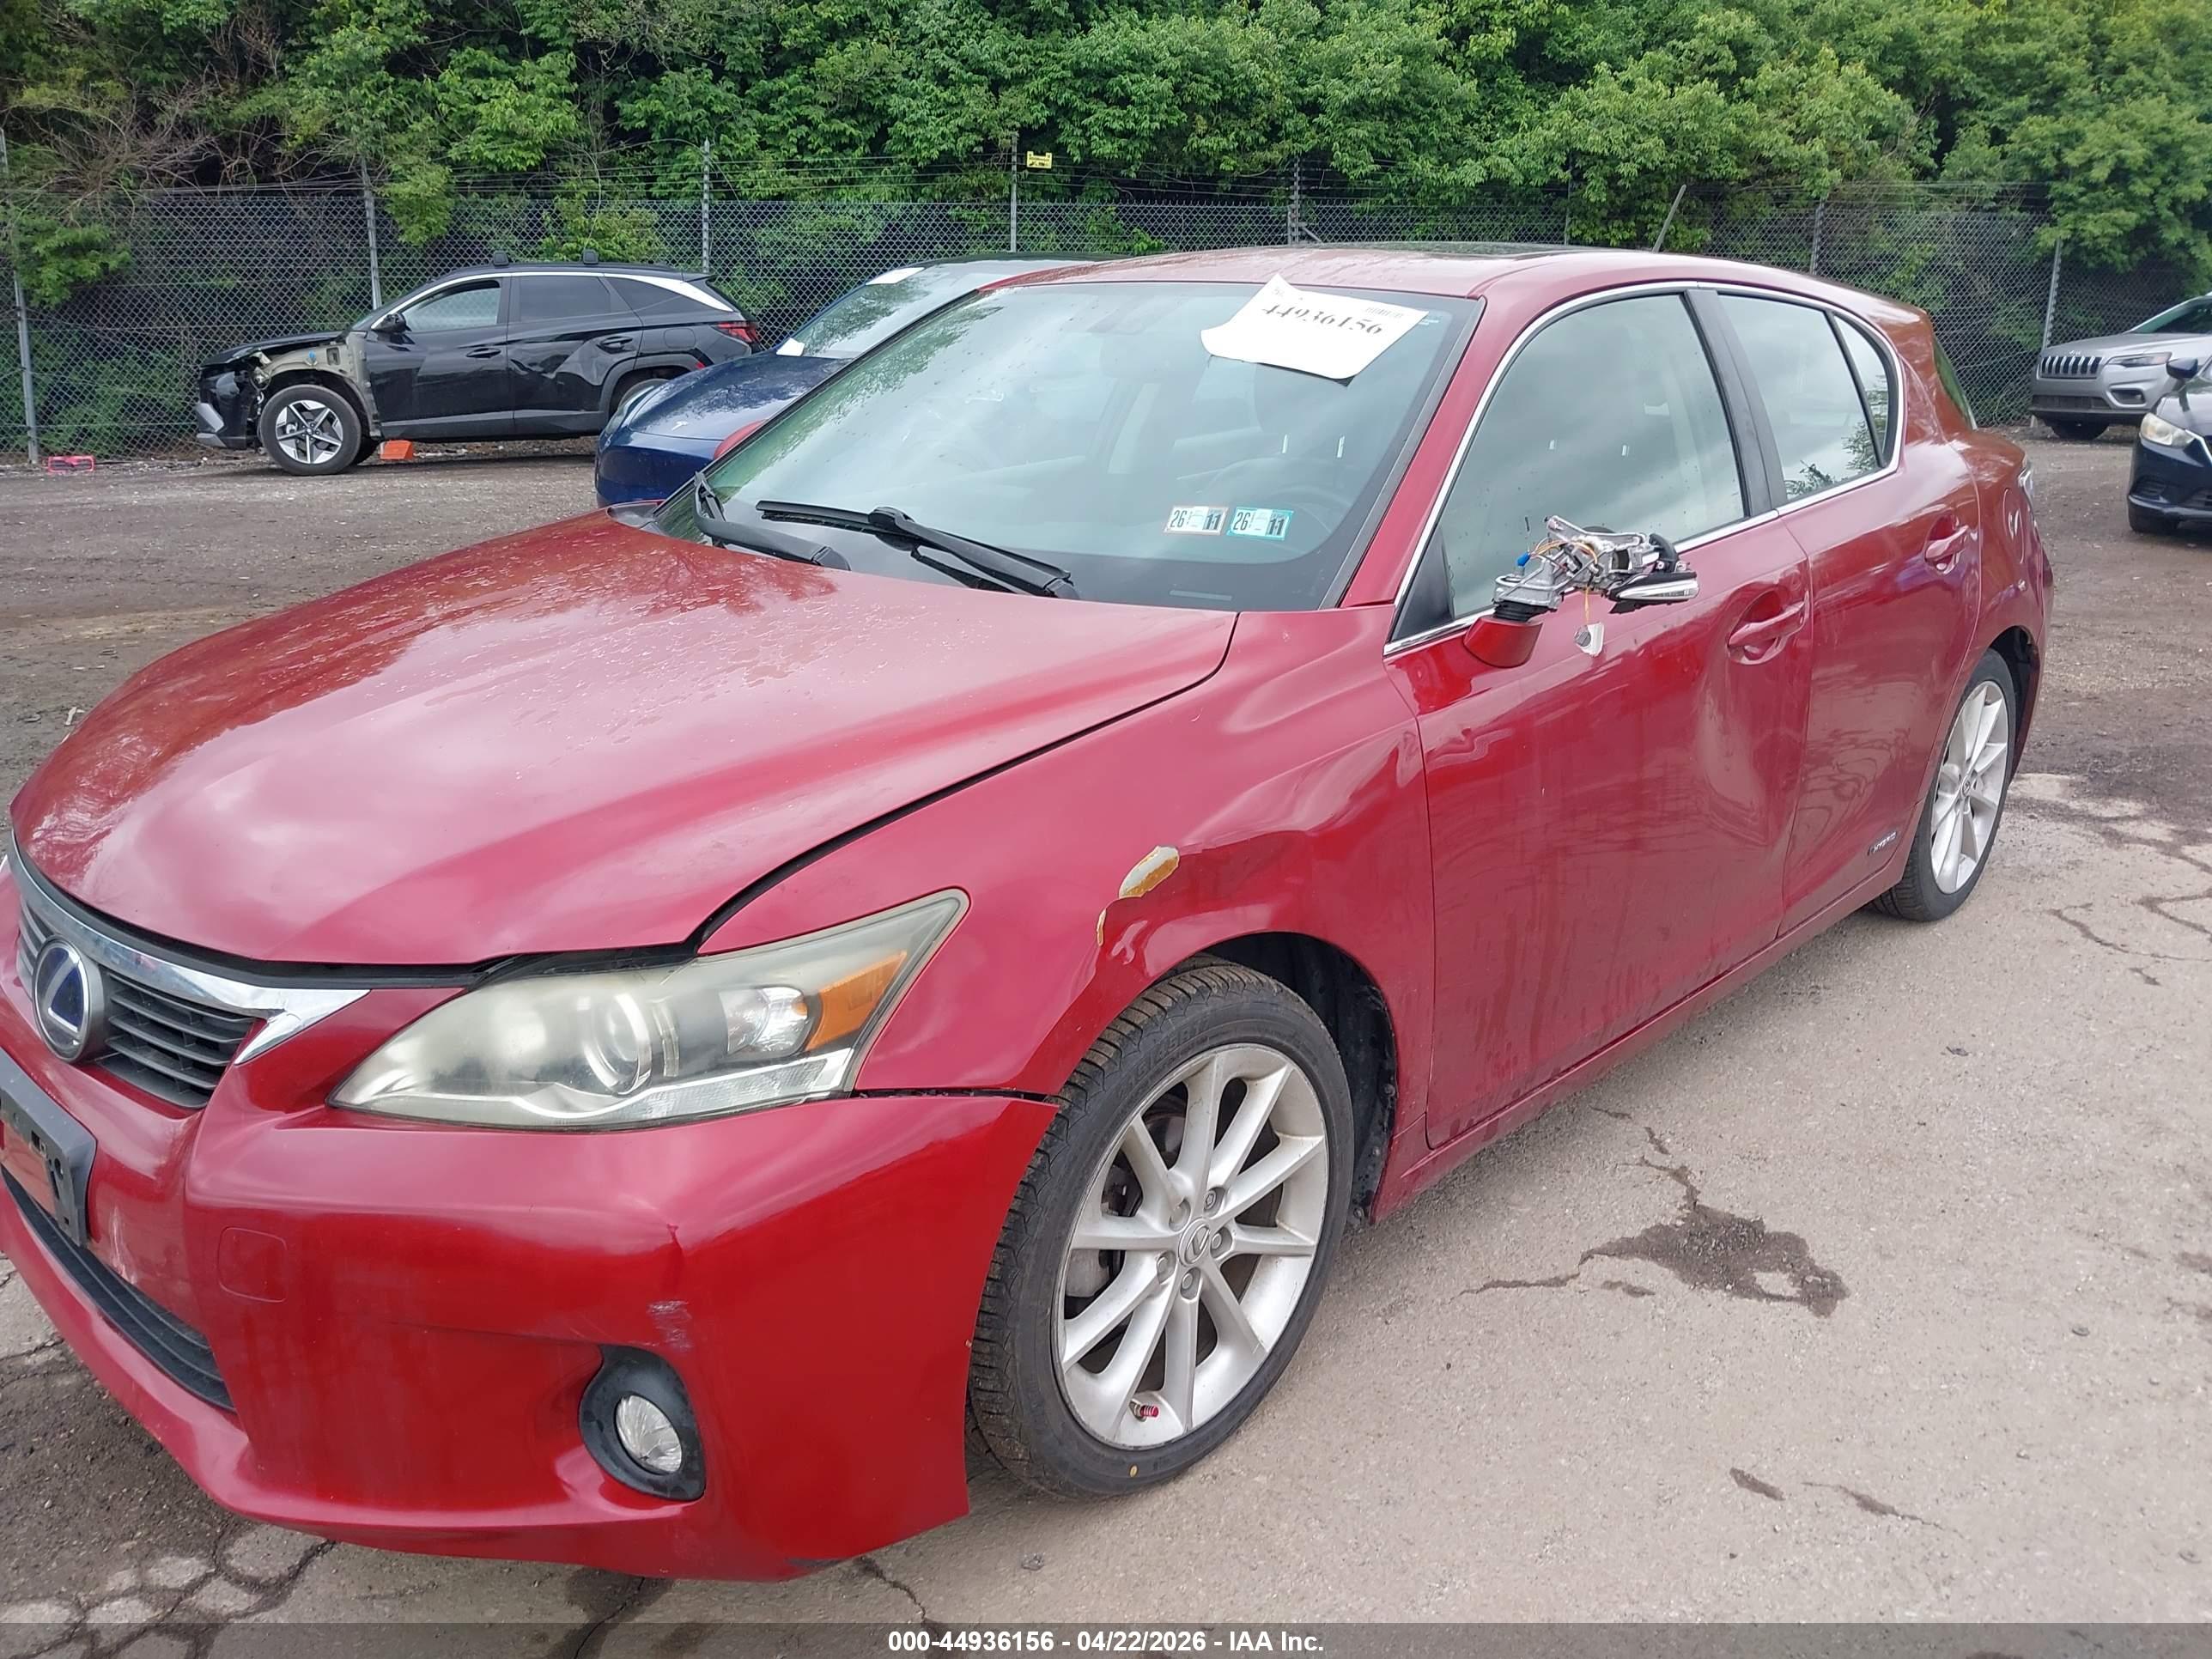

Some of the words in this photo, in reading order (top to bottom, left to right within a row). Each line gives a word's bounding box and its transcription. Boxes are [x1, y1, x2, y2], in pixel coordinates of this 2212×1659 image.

[1261, 304, 1383, 336] 44936156
[1170, 509, 1187, 528] 26
[1206, 514, 1222, 530] 11
[1233, 511, 1251, 531] 26
[1269, 517, 1286, 536] 11
